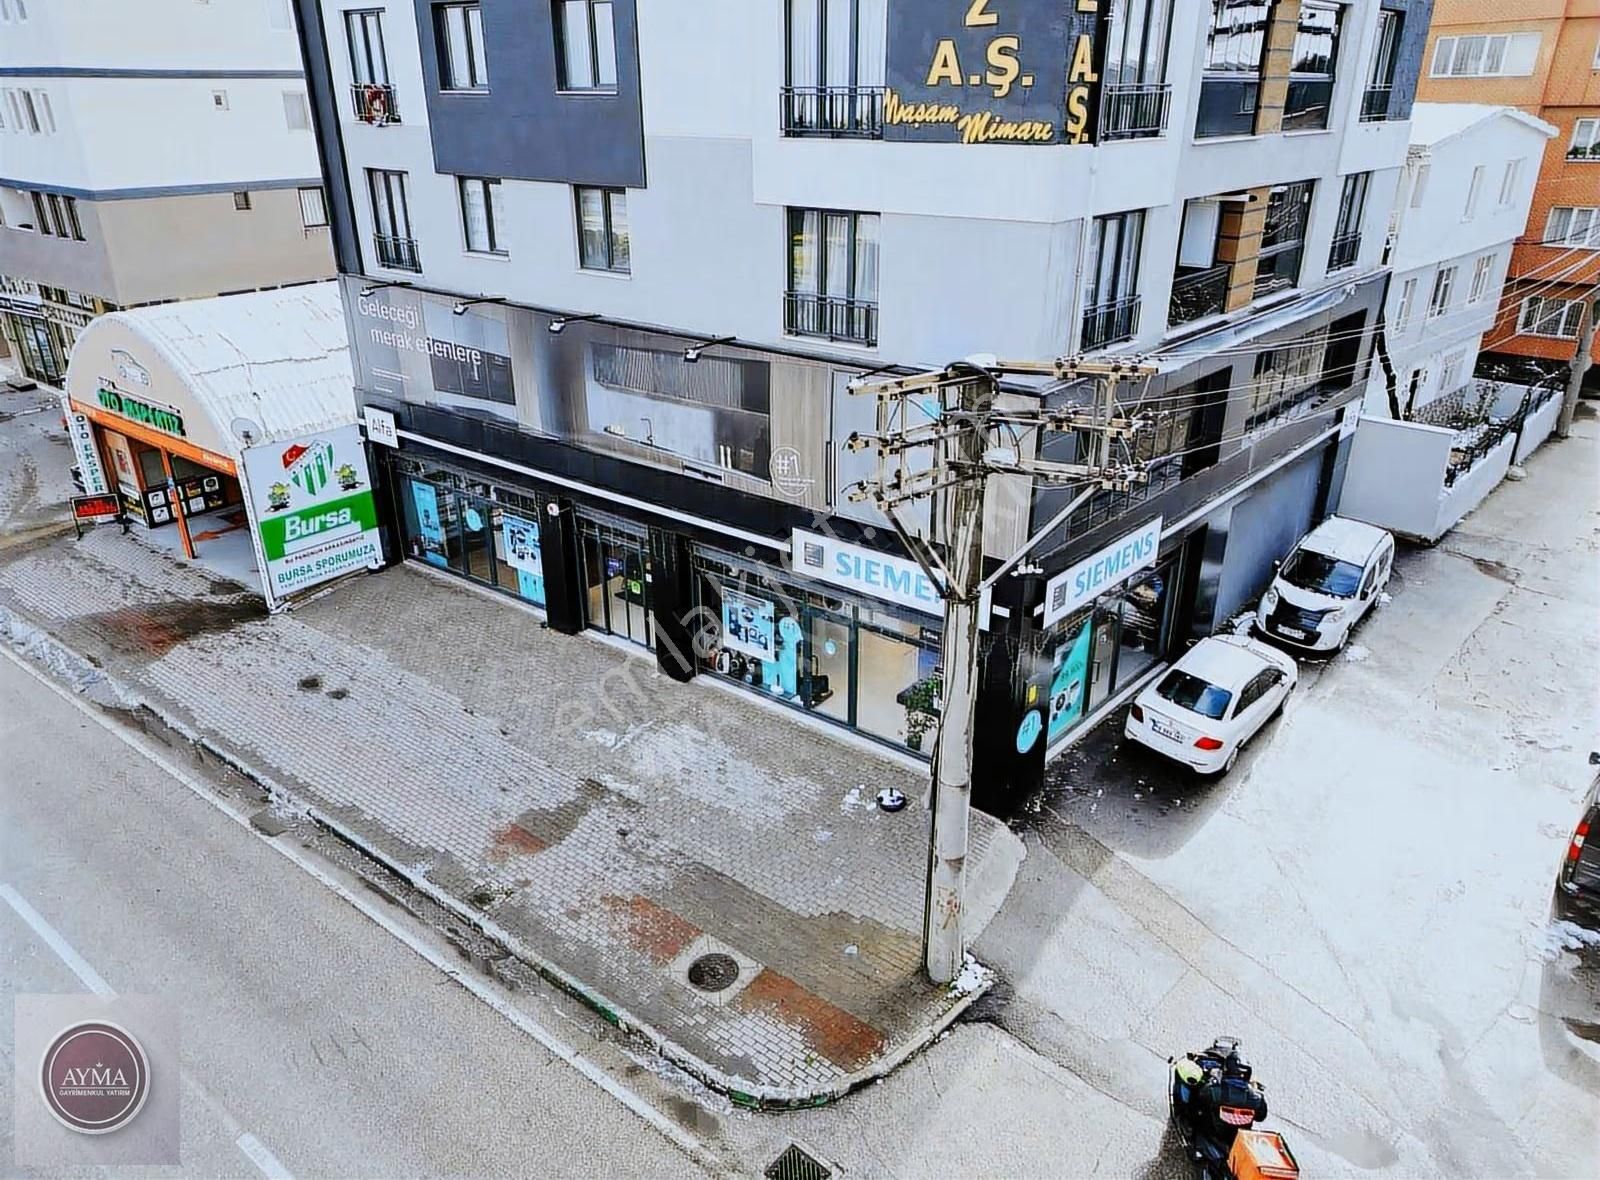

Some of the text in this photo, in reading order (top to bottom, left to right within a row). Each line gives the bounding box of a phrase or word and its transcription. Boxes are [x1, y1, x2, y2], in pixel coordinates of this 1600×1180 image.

[926, 36, 1034, 97] A.Ş.
[358, 297, 419, 328] Geleceği
[370, 328, 482, 365] merak edenlere
[776, 454, 800, 476] #1
[284, 507, 352, 542] Bursa
[277, 564, 314, 584] BURSA
[315, 543, 377, 571] SPORUMUZA
[836, 551, 945, 604] SIEME
[1074, 531, 1154, 599] SIEMENS
